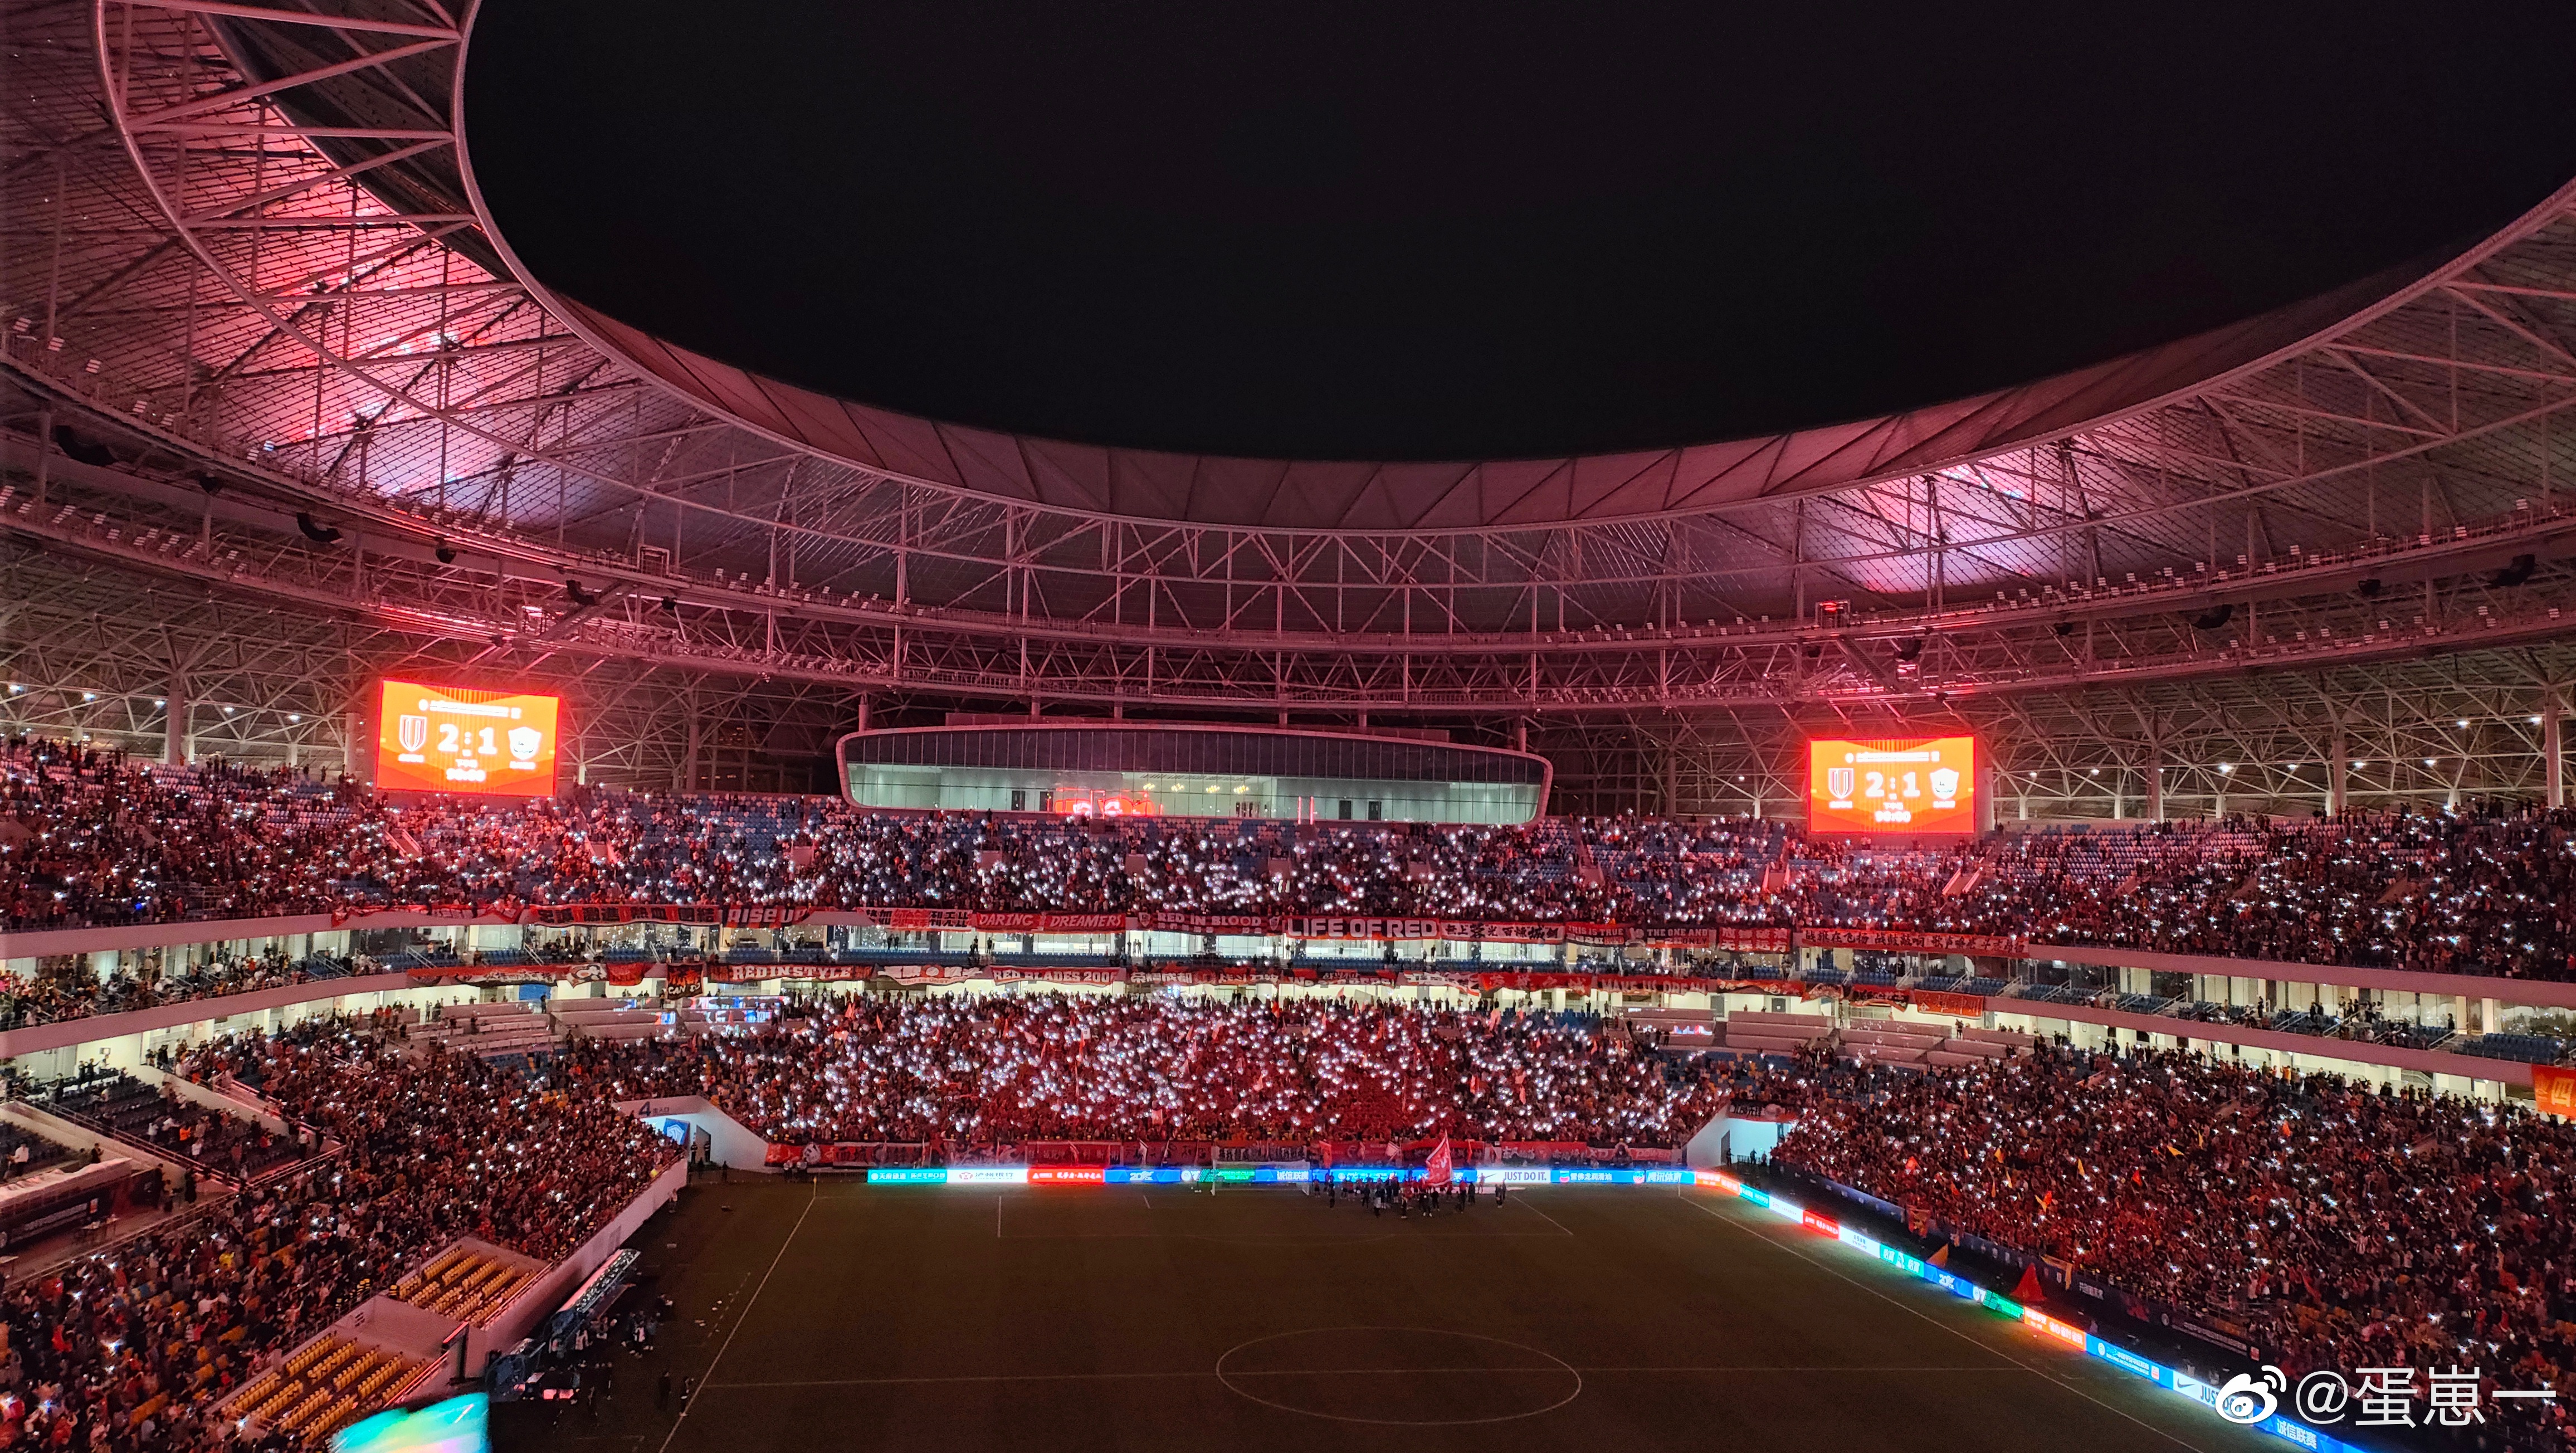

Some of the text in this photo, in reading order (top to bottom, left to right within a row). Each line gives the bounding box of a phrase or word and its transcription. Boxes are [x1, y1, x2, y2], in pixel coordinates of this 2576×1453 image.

[979, 913, 1121, 928] DARING DREAMERS
[1158, 912, 1262, 926] RED IN BLOOD
[1287, 917, 1437, 938] LIFE OF RED
[732, 966, 767, 979] RED
[770, 966, 790, 976] IN
[793, 966, 852, 979] STYLE
[993, 969, 1021, 980] RED
[1024, 971, 1081, 982] BLADES
[668, 986, 685, 994] CAN
[638, 1101, 651, 1116] 4
[1504, 1172, 1547, 1181] JUST DO IT.
[2276, 1418, 2318, 1449] 诚信联赛
